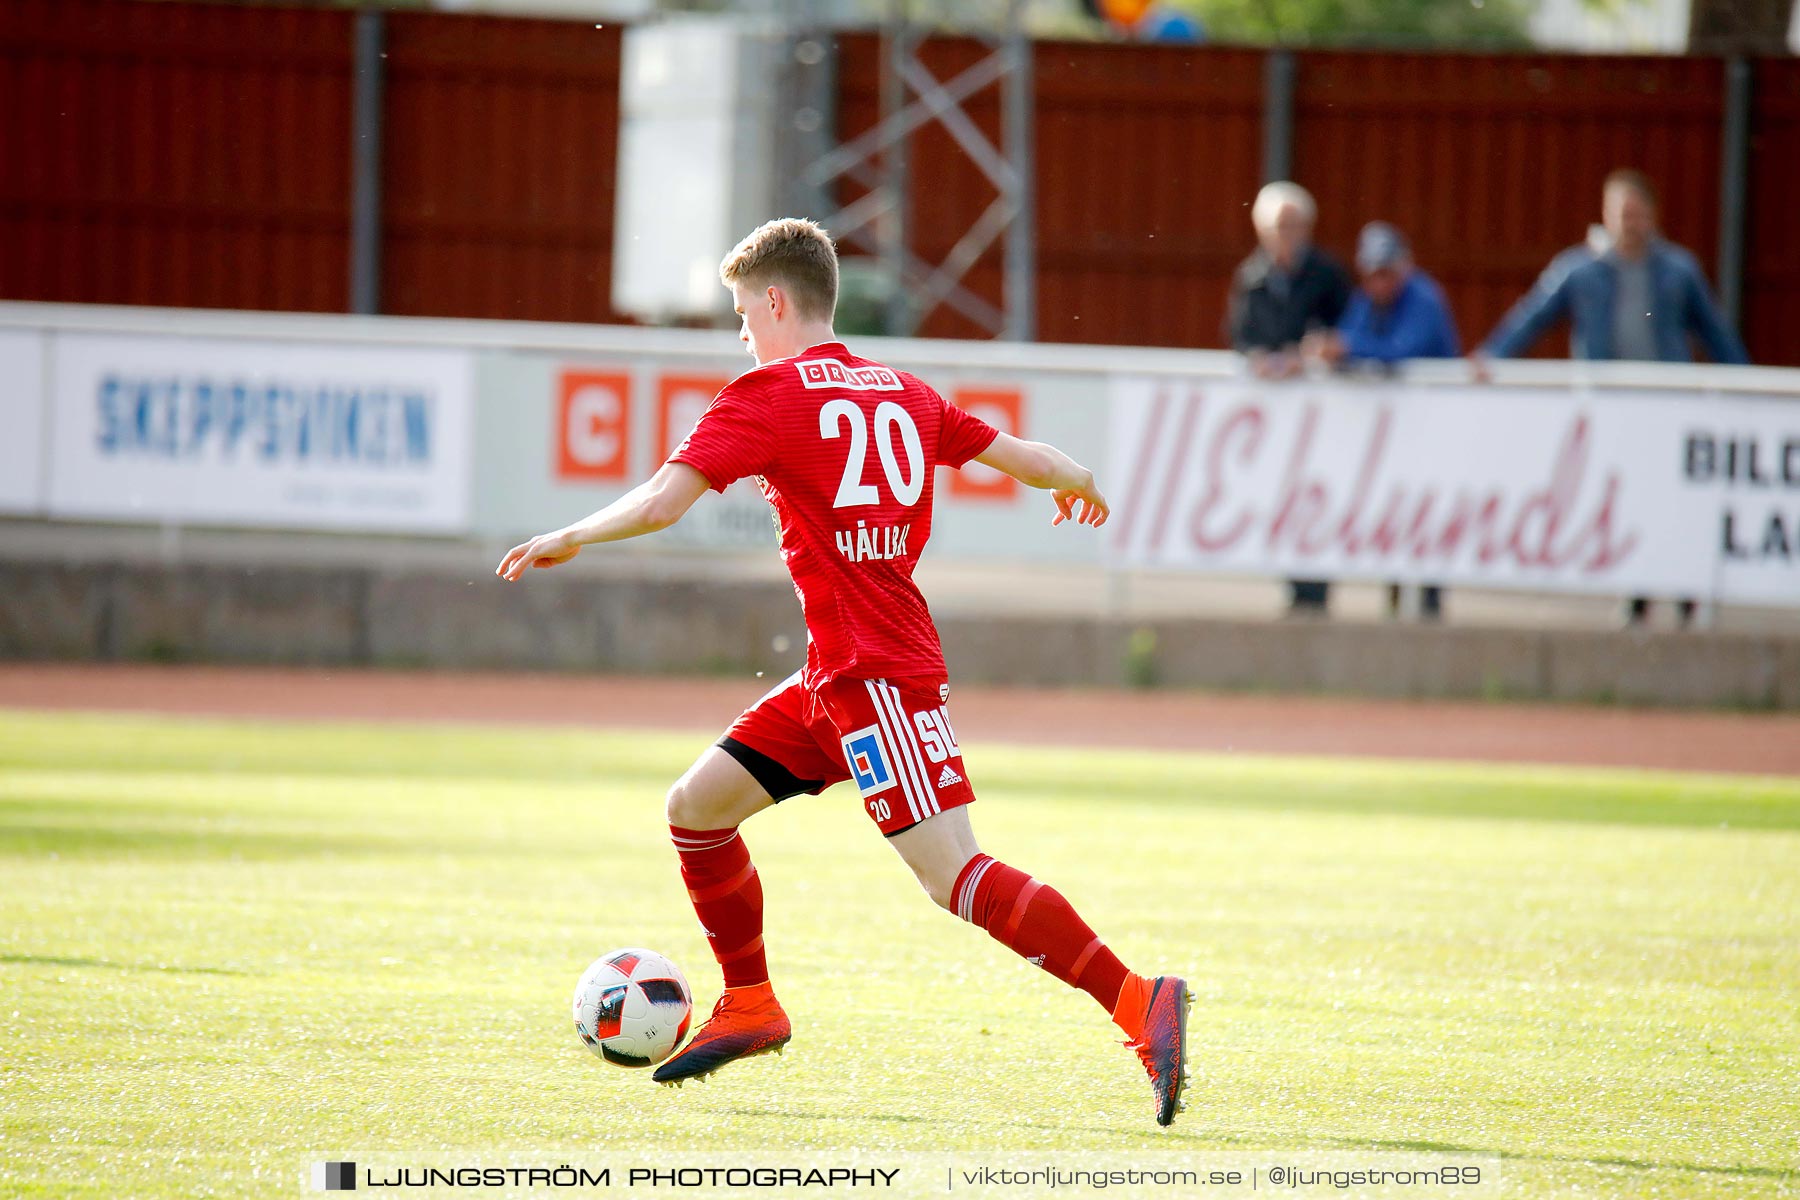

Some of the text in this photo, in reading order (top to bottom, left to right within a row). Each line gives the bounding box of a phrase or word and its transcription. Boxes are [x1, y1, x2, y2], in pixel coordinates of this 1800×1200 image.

[806, 366, 894, 385] CRAMO
[98, 375, 432, 460] SKEPPSVIKEN
[818, 399, 925, 508] 20
[1722, 509, 1800, 562] LA
[937, 775, 963, 789] adidas
[869, 797, 891, 822] 20
